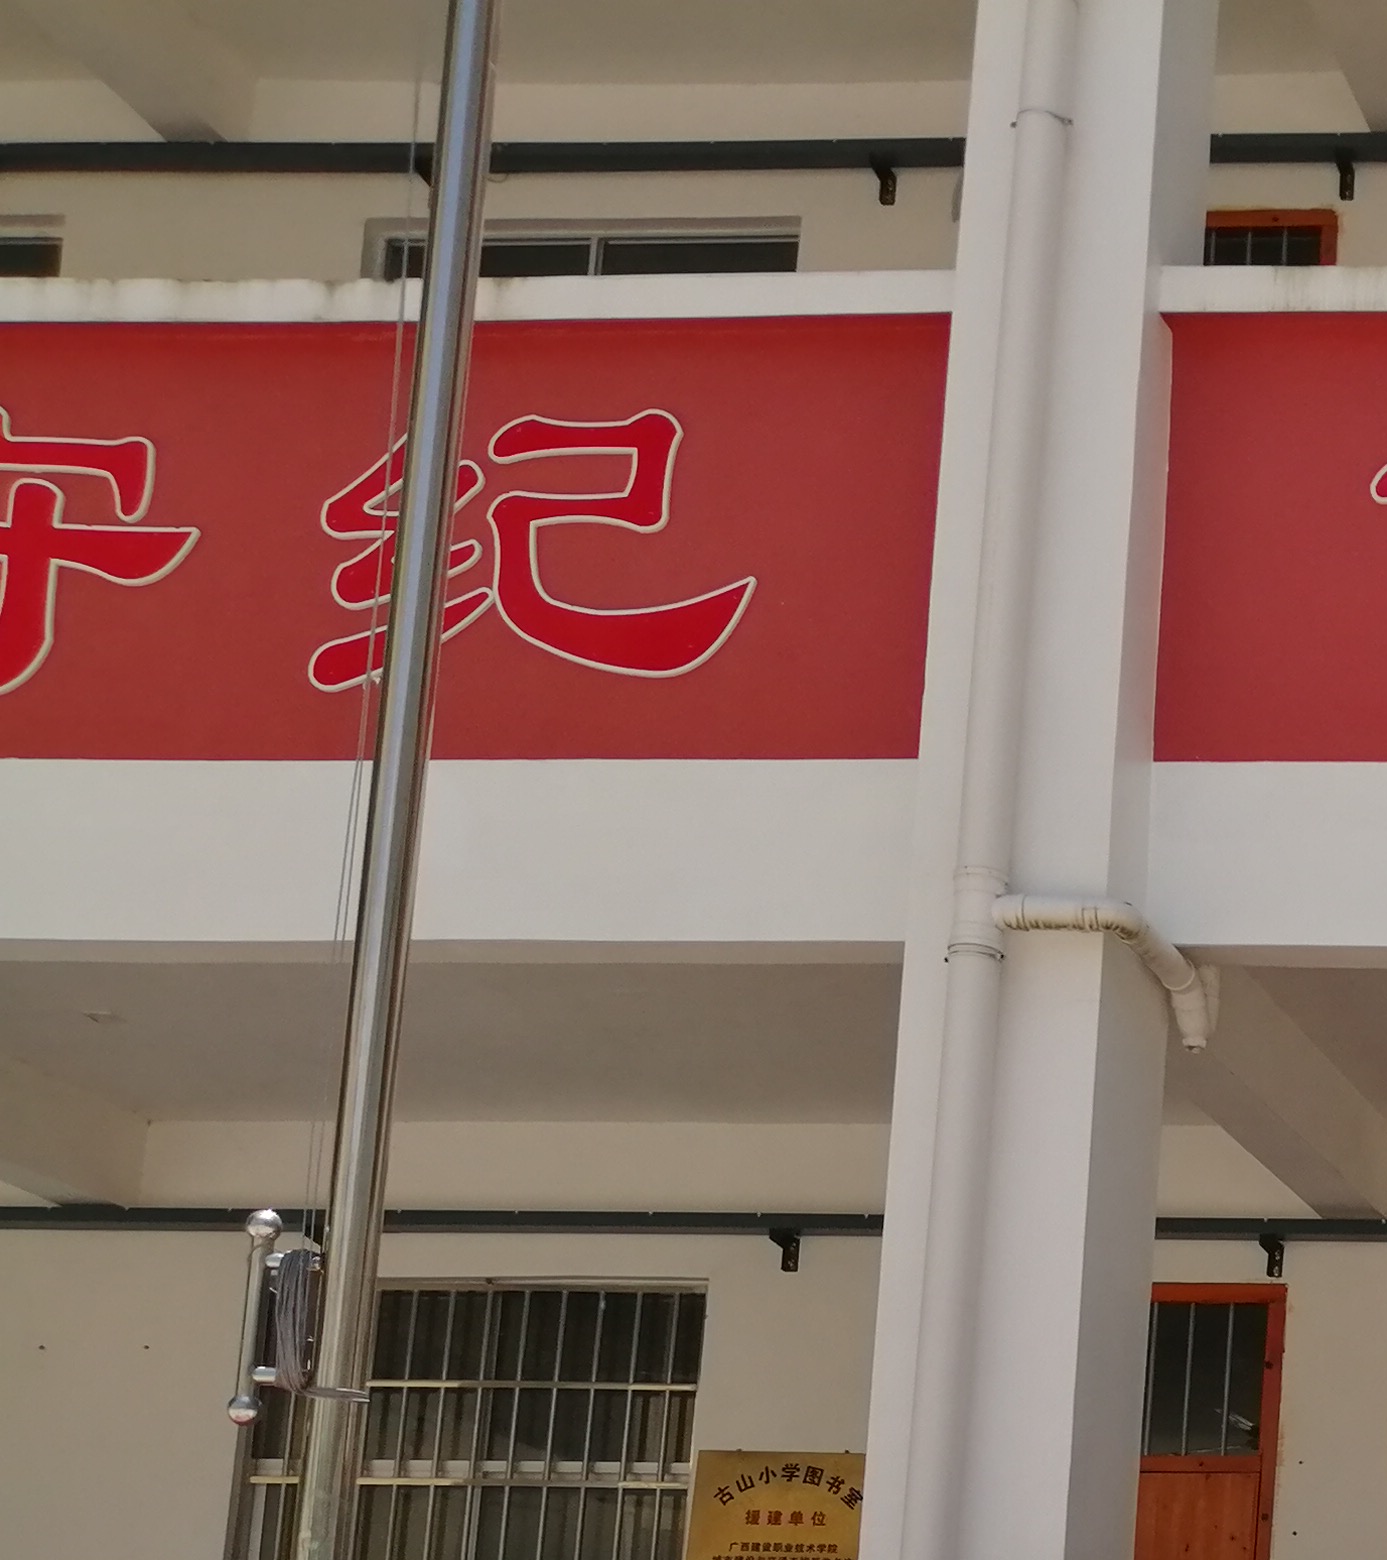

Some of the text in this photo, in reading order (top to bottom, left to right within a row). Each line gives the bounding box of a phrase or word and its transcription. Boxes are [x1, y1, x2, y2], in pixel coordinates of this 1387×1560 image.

[713, 1462, 864, 1511] 古山小学图书室
[745, 1509, 827, 1526] 援建单位
